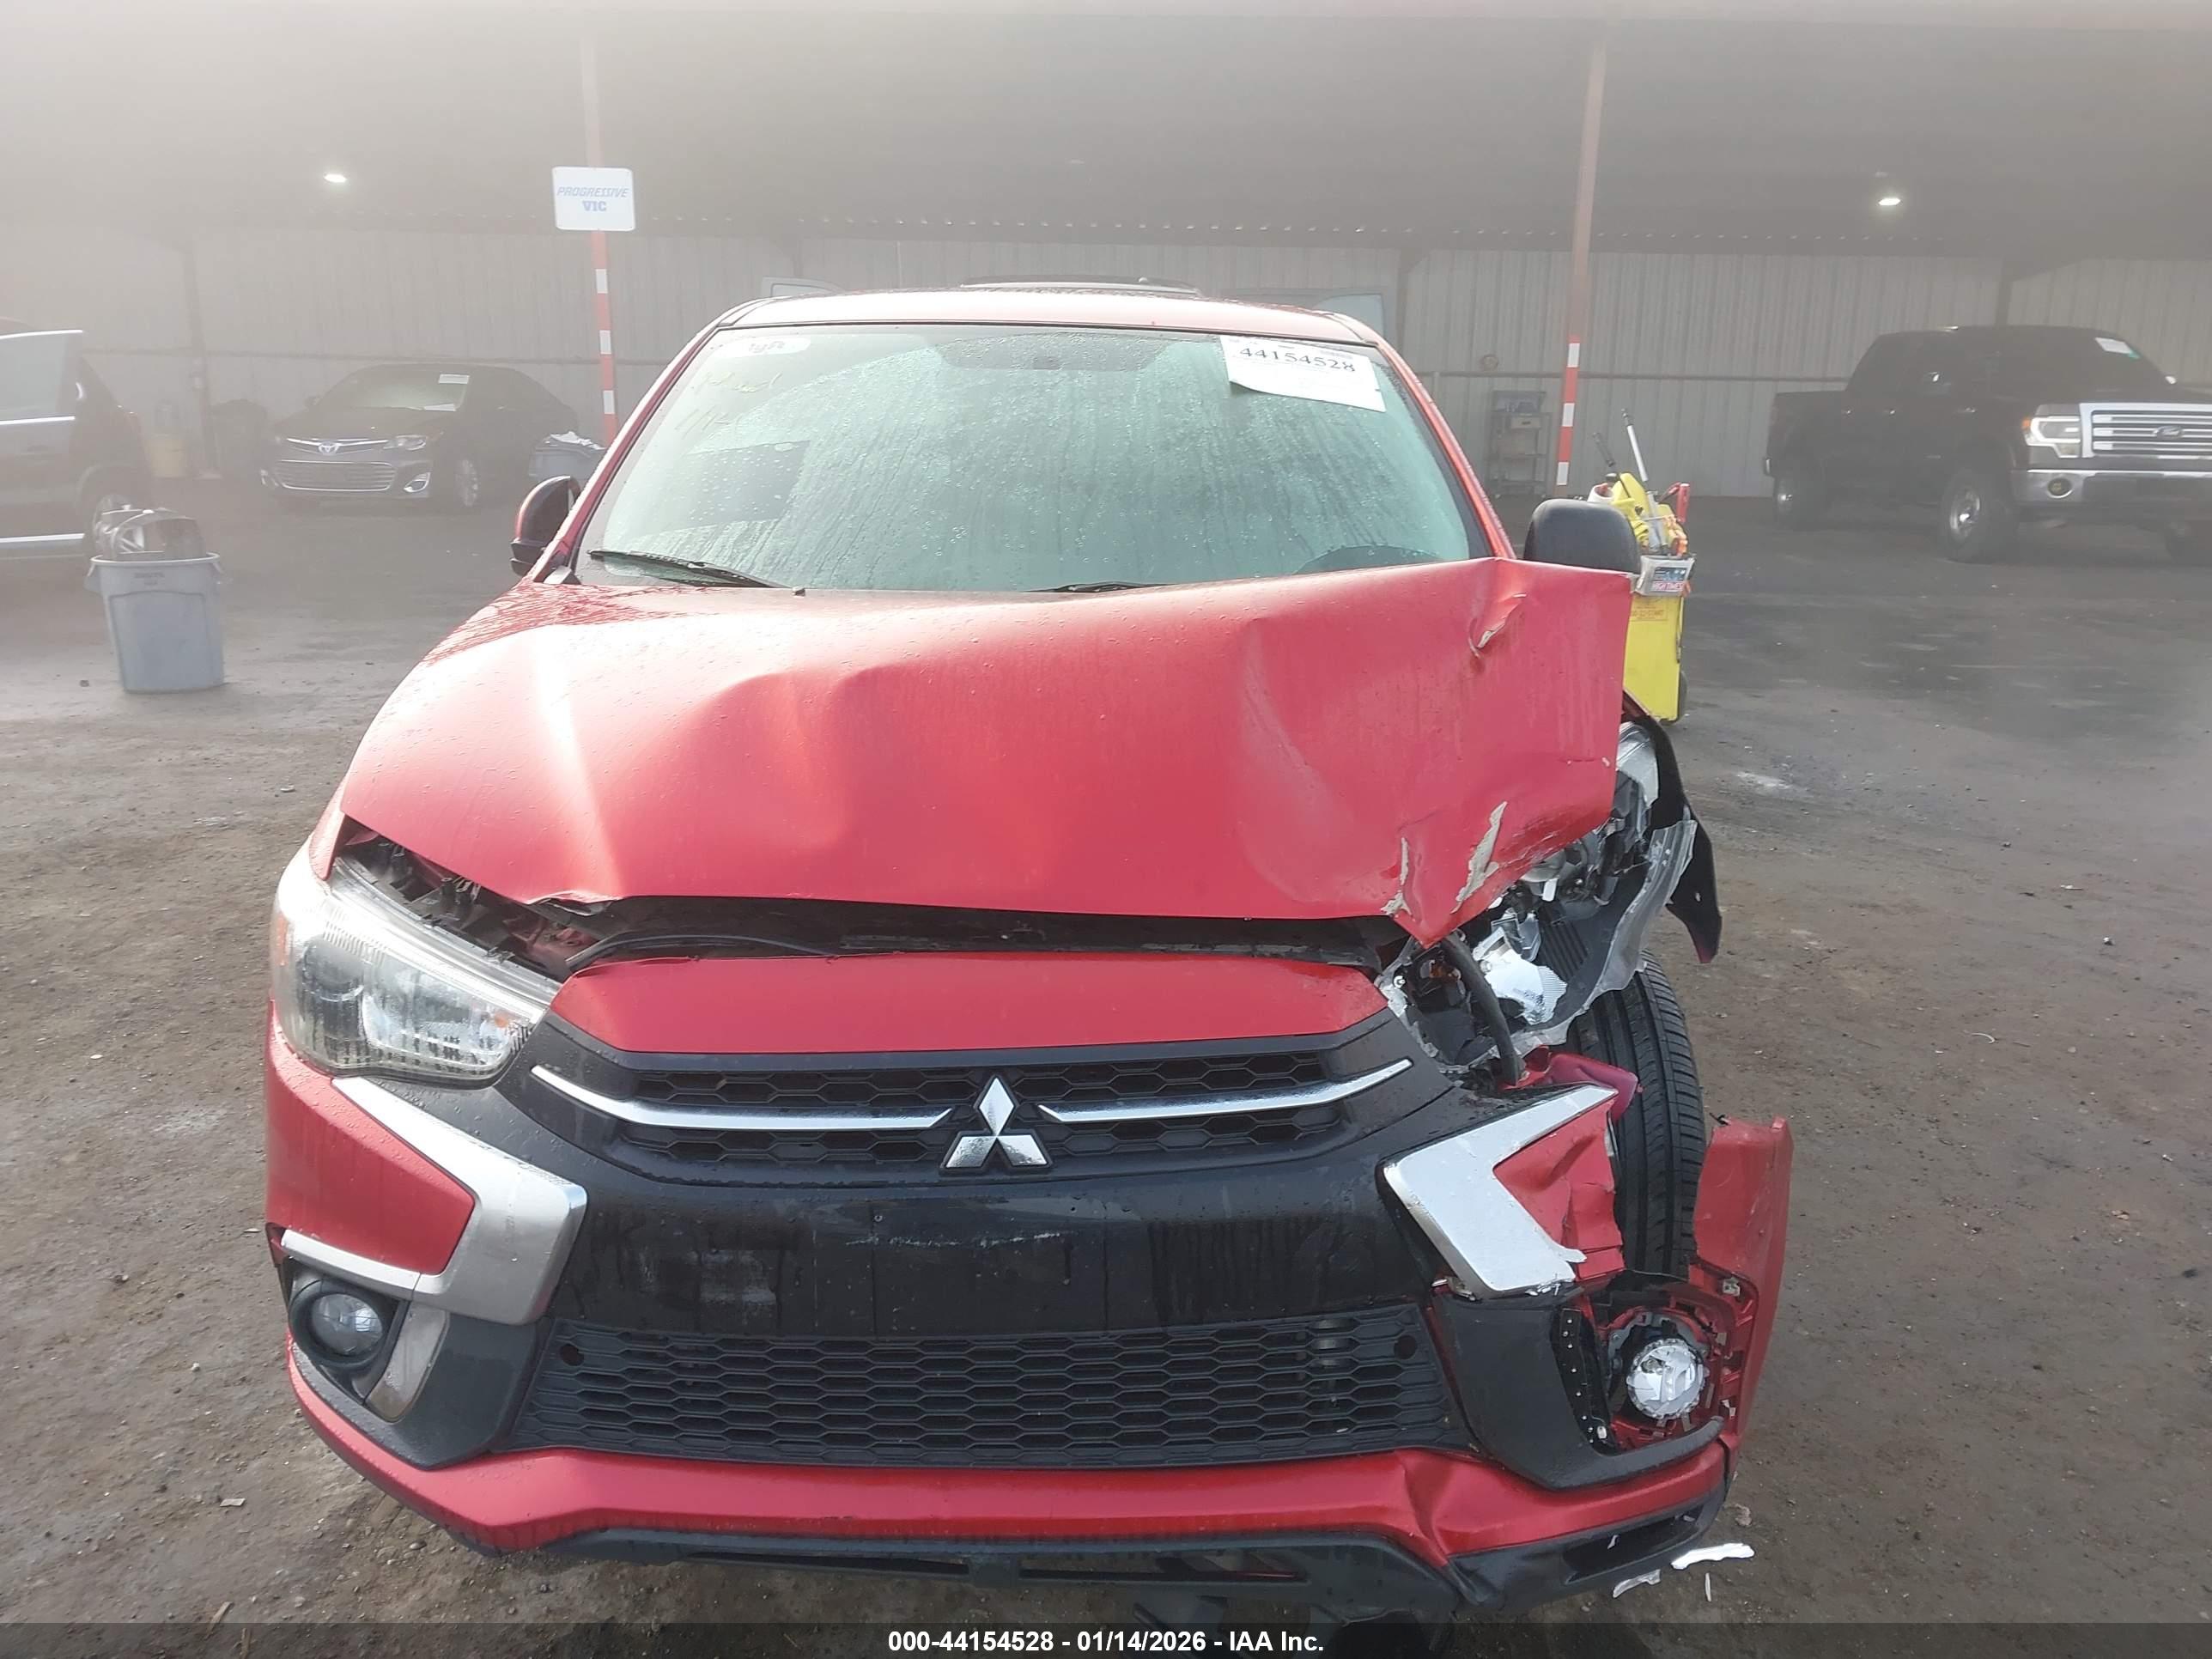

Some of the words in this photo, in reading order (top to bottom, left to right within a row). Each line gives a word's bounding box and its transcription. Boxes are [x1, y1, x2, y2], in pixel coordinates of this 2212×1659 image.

[556, 185, 629, 198] PROGRESSIVE
[581, 201, 607, 212] VIC
[1239, 347, 1356, 373] 44154528
